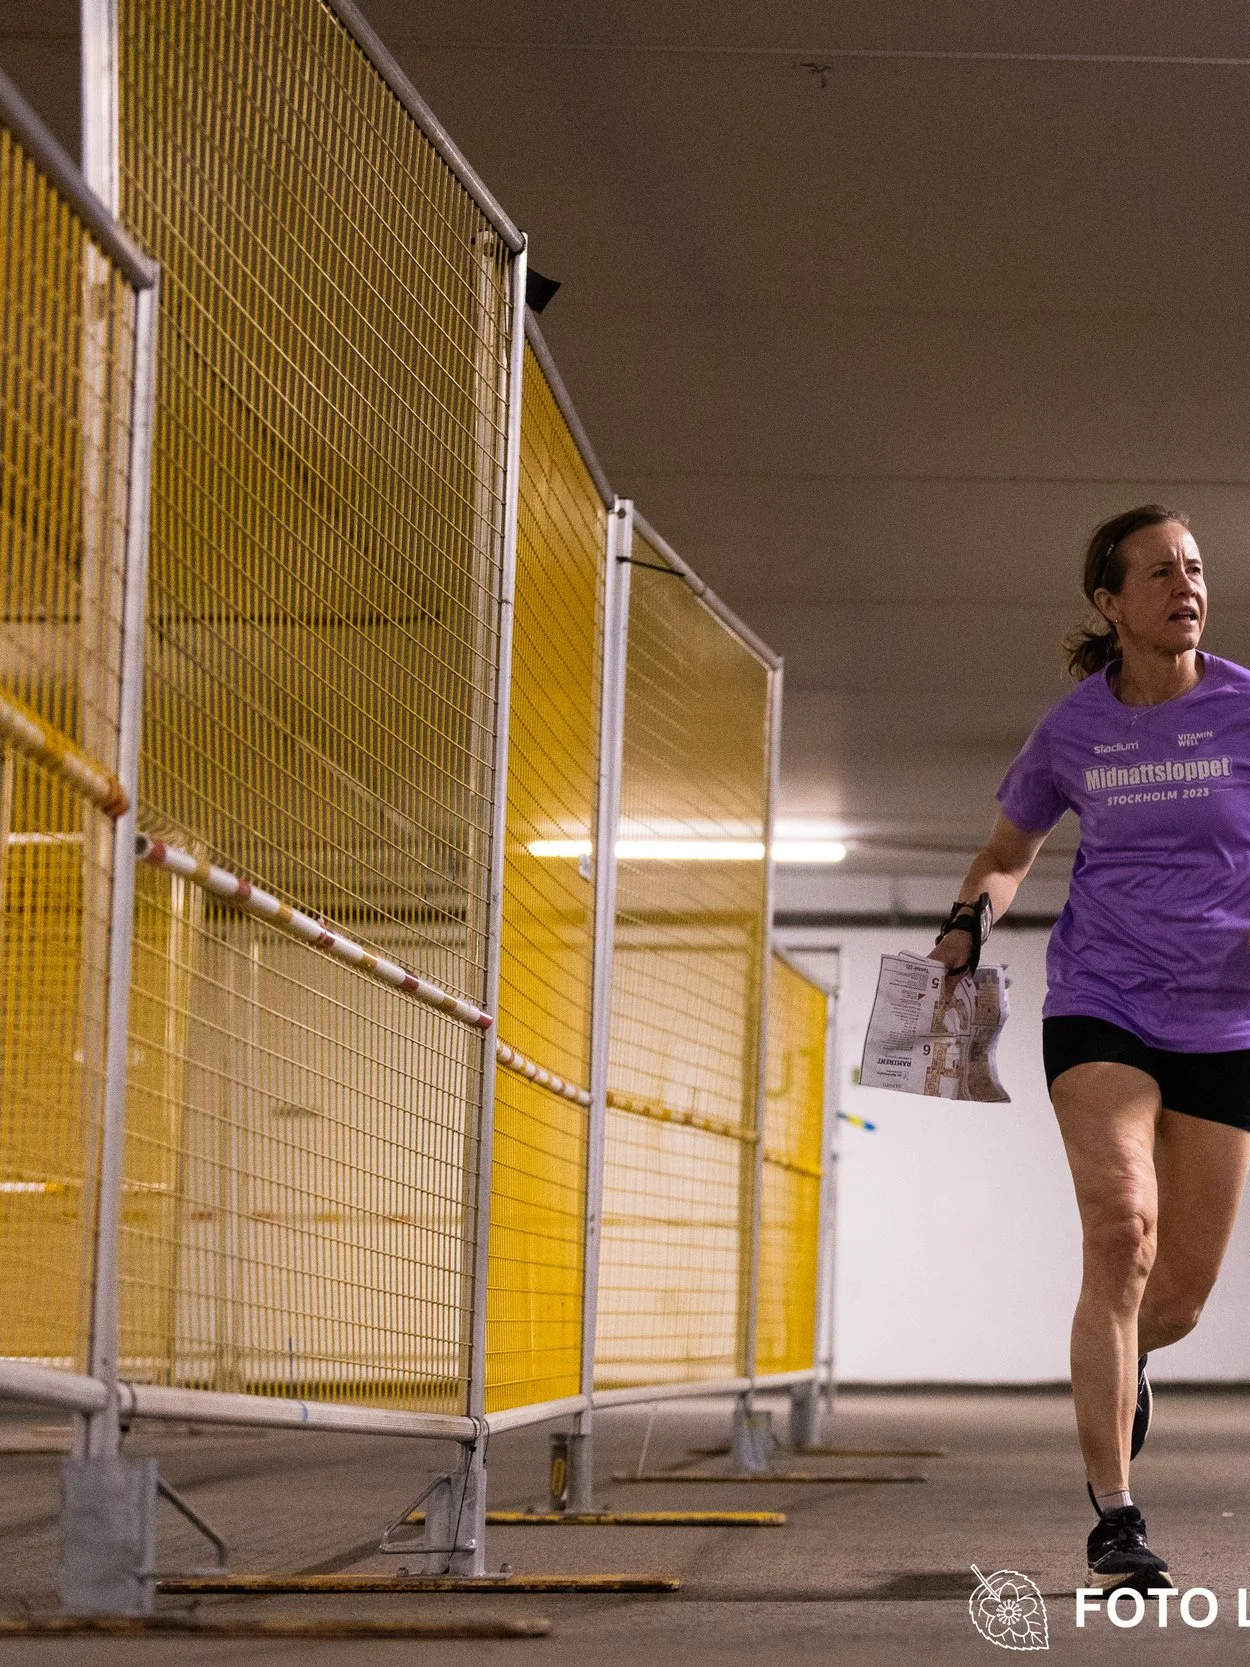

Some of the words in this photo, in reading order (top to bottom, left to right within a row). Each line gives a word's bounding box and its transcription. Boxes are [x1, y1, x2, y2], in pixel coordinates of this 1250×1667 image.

[1177, 730, 1213, 740] VITAMIN
[1093, 740, 1139, 754] stadium
[1178, 738, 1199, 747] WELL
[1085, 757, 1231, 791] Midnattsloppet
[1107, 790, 1178, 806] STOCKHOLM
[1182, 787, 1210, 799] 2023
[931, 977, 940, 989] 5
[923, 1044, 931, 1055] 6
[877, 1058, 912, 1067] RAMIRENT
